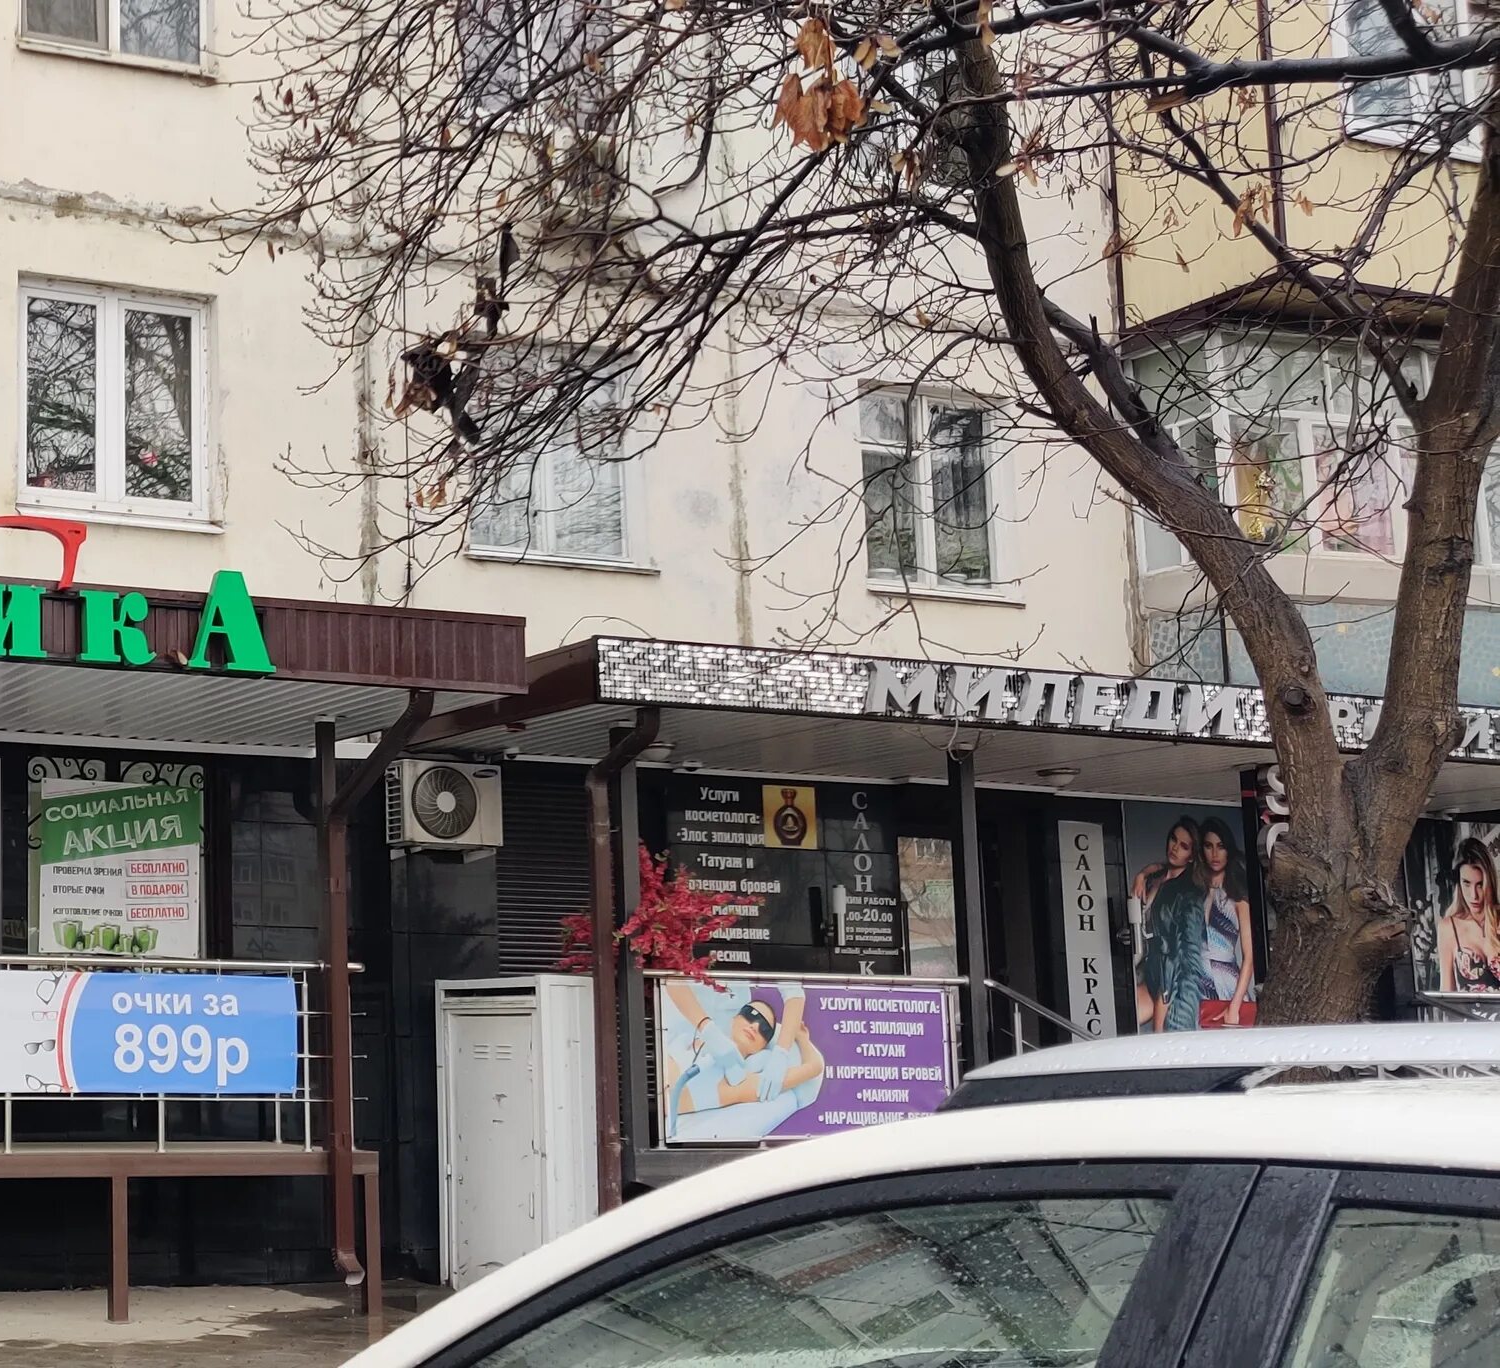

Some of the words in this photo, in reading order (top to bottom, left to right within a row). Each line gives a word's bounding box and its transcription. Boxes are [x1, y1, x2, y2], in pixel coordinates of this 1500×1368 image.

[866, 660, 1240, 738] МИЛЕДИ
[699, 787, 740, 803] Услуги
[45, 788, 189, 822] СОЦИАЛЬНАЯ
[684, 809, 761, 825] косметолога:
[63, 814, 183, 856] АКЦИЯ
[710, 830, 765, 846] эпиляция
[852, 792, 874, 893] САЛОН
[52, 865, 92, 875] ПРОВЕРКА
[93, 867, 123, 877] ЗРЕНИЯ
[130, 862, 185, 874] БЕСПЛАТНО
[745, 857, 754, 869] и
[52, 885, 84, 894] ВТОРЫЕ
[85, 885, 105, 895] ОЧКИ
[131, 885, 138, 895] В
[140, 884, 184, 896] ПОДАРОК
[740, 878, 781, 894] бровей
[1074, 834, 1096, 931] САЛОН
[864, 897, 897, 906] РАБОТЫ
[130, 907, 185, 919] БЕСПЛАТНО
[112, 992, 192, 1015] очки
[203, 993, 240, 1016] за
[820, 997, 861, 1011] УСЛУГИ
[865, 998, 940, 1013] КОСМЕТОЛОГА:
[870, 1021, 924, 1037] ЭПИЛЯЦИЯ
[113, 1023, 249, 1087] 899р
[826, 1066, 834, 1079] И
[837, 1066, 899, 1081] КОРРЕКЦИЯ
[902, 1066, 942, 1081] БРОВЕЙ
